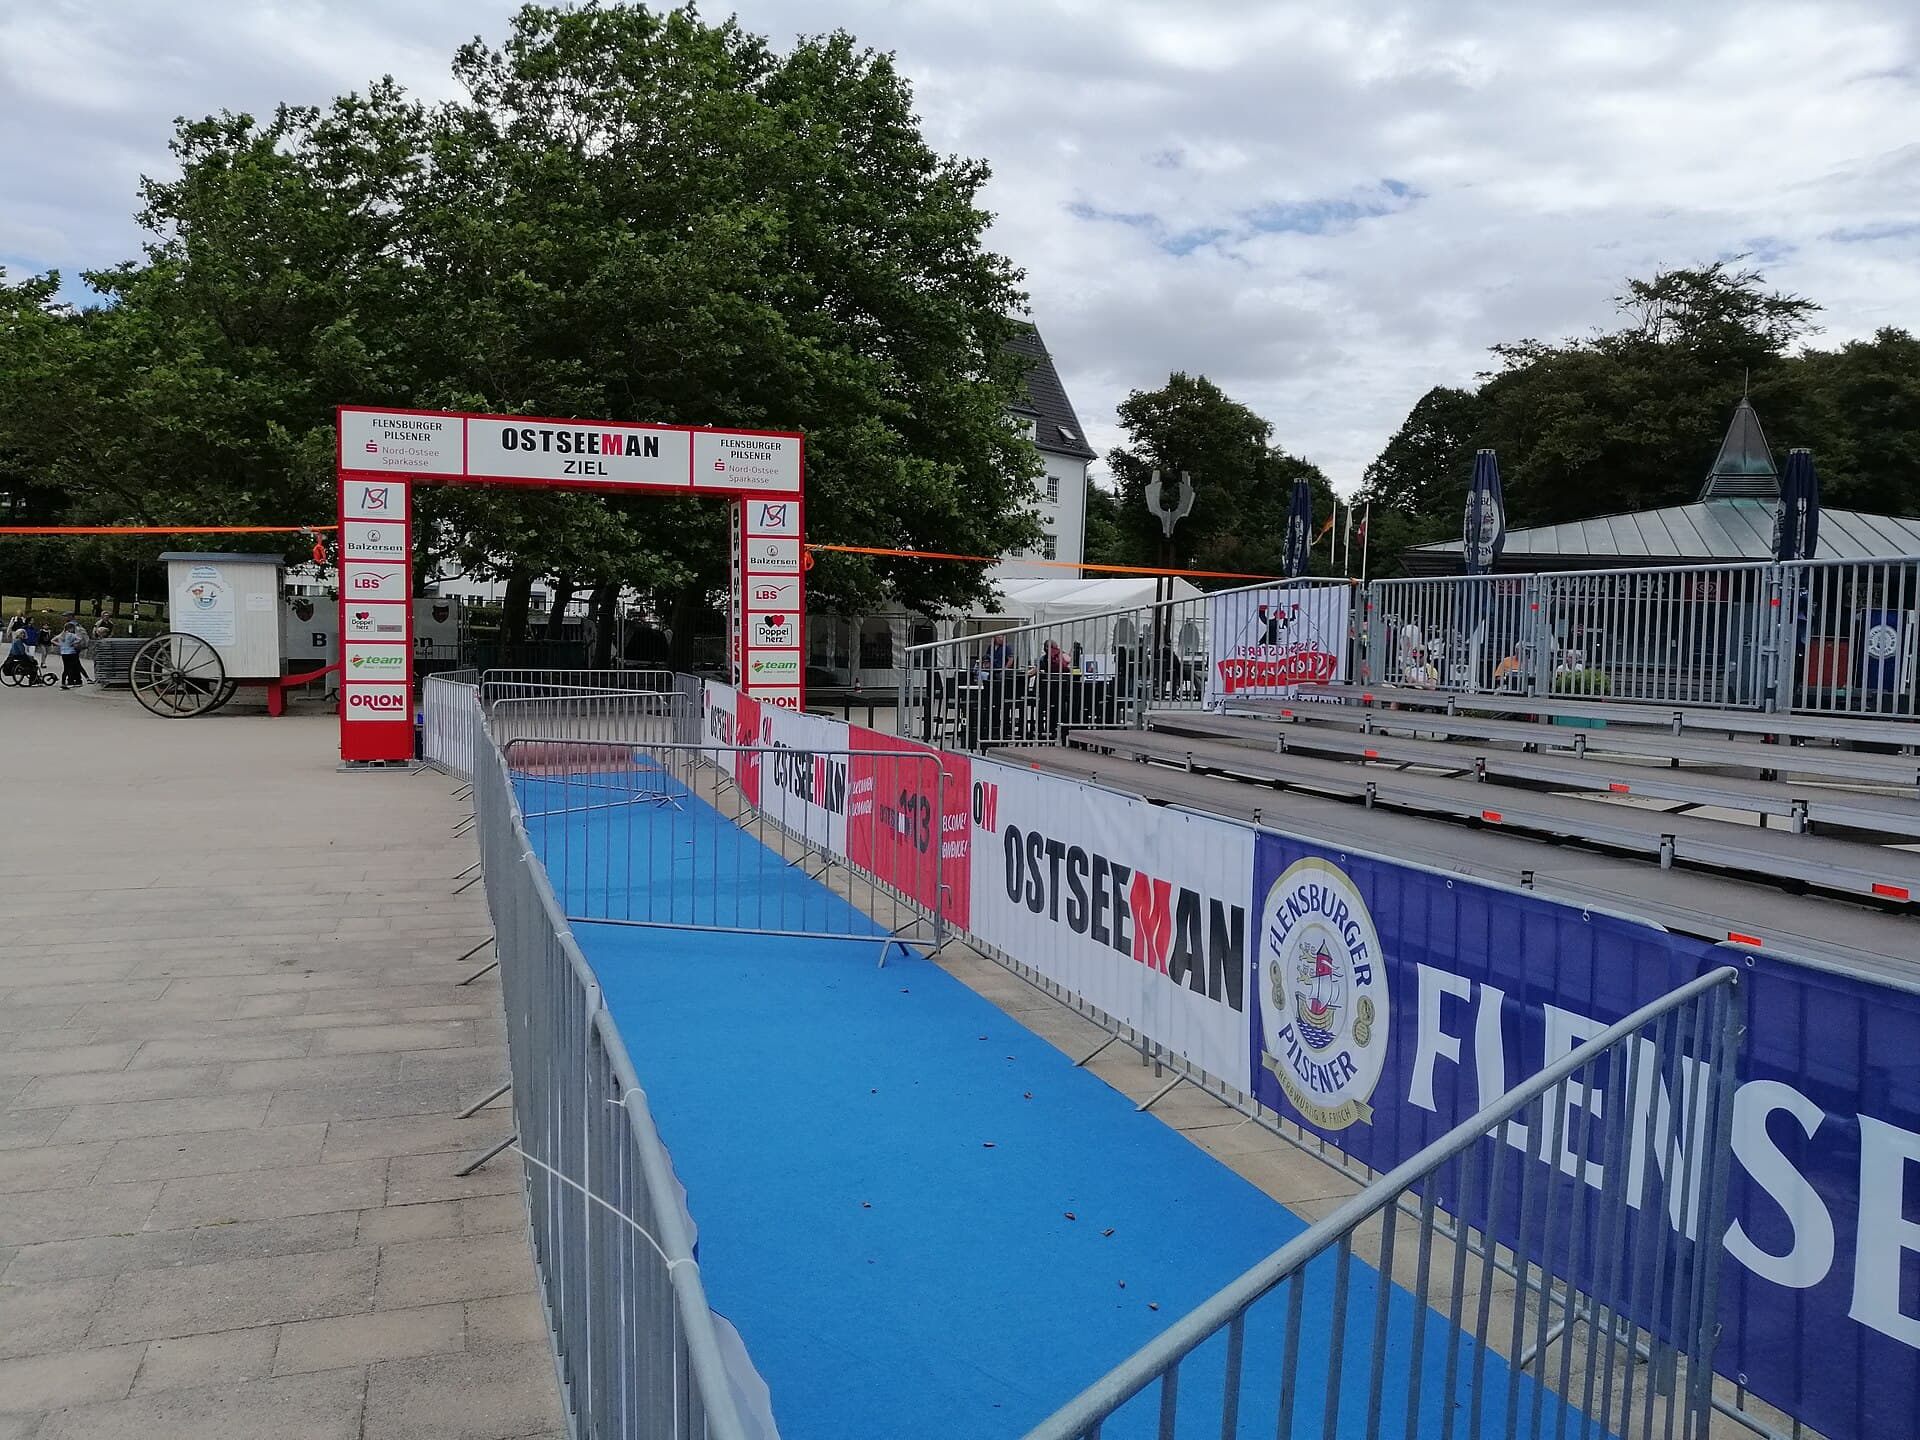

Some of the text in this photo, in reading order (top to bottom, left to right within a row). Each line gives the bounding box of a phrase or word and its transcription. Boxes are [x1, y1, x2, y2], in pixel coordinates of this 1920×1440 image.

[372, 418, 442, 431] FLENSBURGER
[384, 430, 431, 442] PILSENER
[501, 427, 660, 458] OSTSEEMAN
[720, 439, 782, 451] FLENSBURGER
[382, 446, 440, 457] Nord-Ostsee
[730, 450, 772, 461] PILSENER
[382, 456, 429, 467] Sparkasse
[564, 460, 608, 476] ZIEL
[728, 464, 779, 475] Nord-Ostsee
[728, 474, 770, 485] Sparkasse
[347, 542, 403, 552] Balzersen
[750, 557, 797, 565] Balzersen
[354, 579, 380, 589] LBS
[755, 590, 778, 600] LBS
[759, 627, 789, 637] Doppel
[765, 635, 784, 643] herz
[366, 655, 404, 665] team
[765, 661, 797, 669] team
[350, 694, 404, 711] ORION
[973, 780, 999, 834] OM
[942, 812, 968, 833] ELCOME!
[1003, 824, 1246, 1014] OSTSEEMAN
[1269, 883, 1372, 988] FLENSBURGER
[1278, 1022, 1358, 1094] PILSENER
